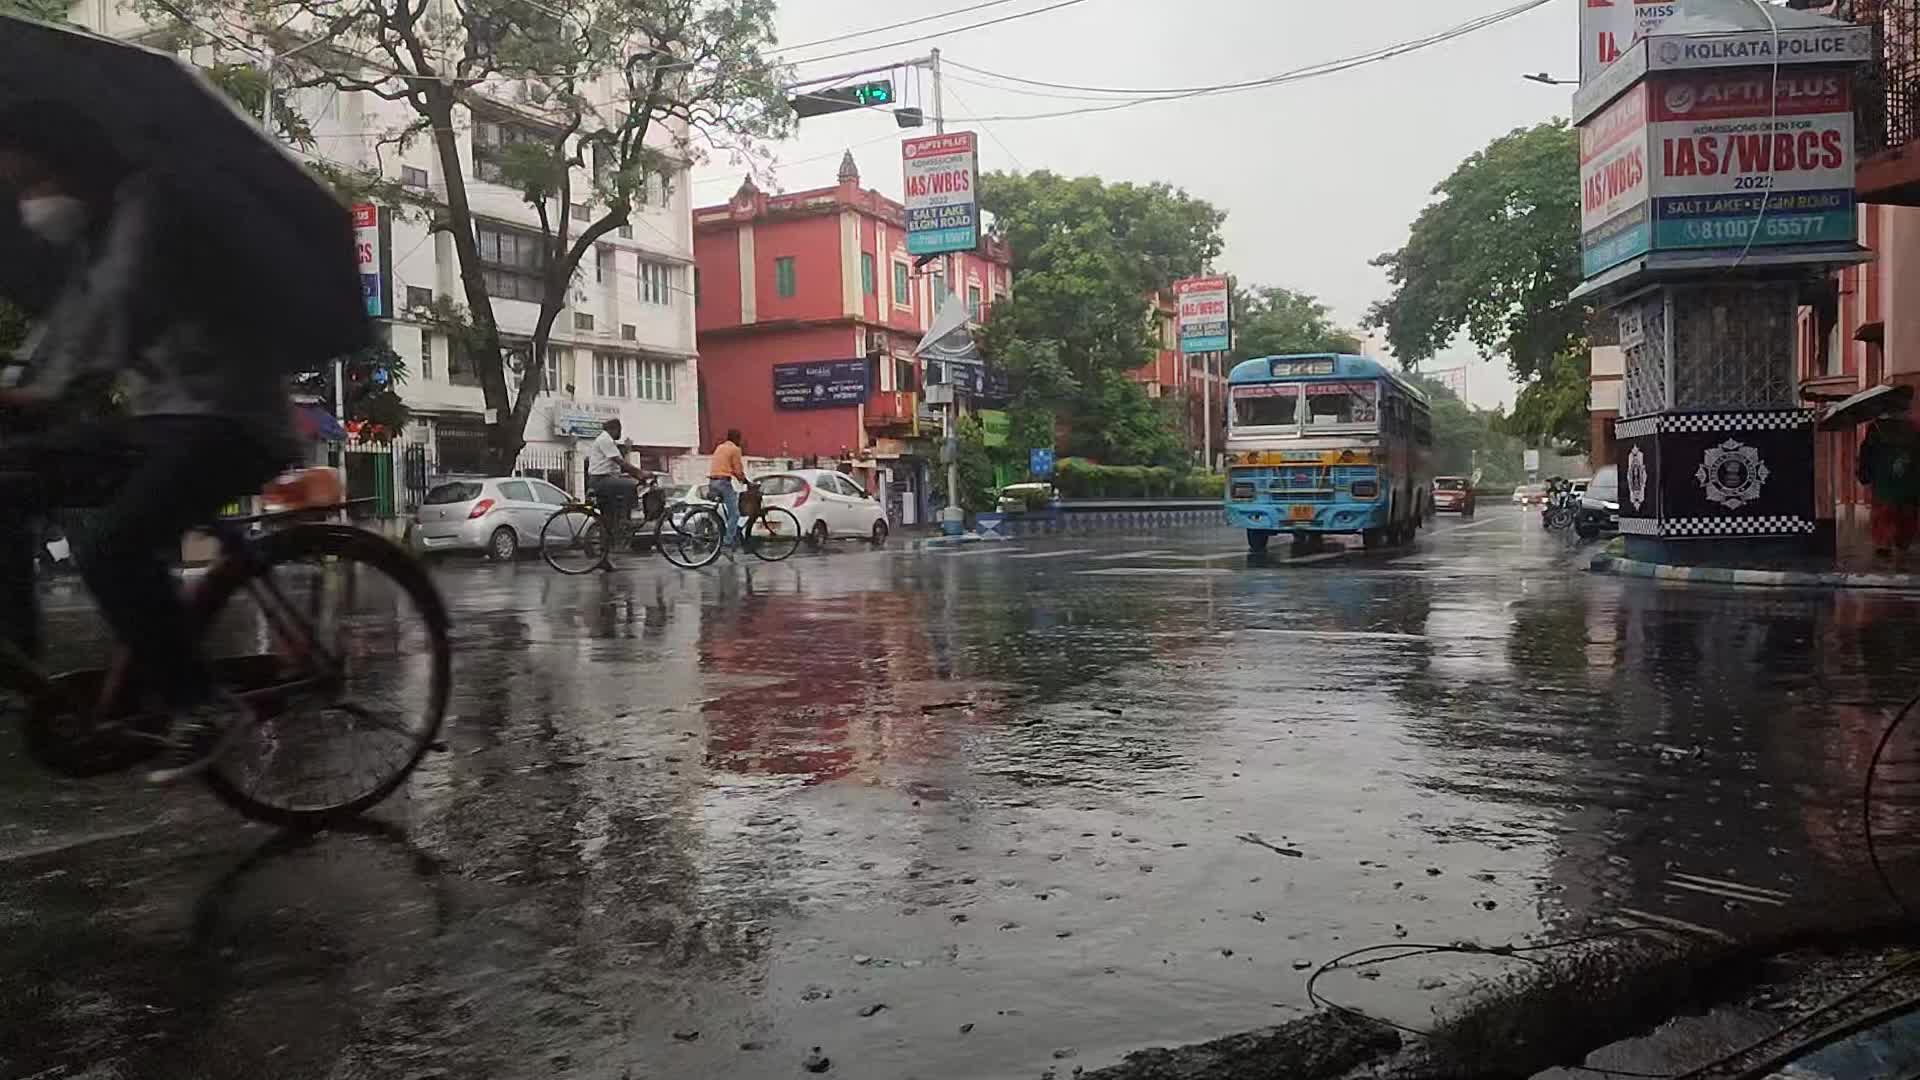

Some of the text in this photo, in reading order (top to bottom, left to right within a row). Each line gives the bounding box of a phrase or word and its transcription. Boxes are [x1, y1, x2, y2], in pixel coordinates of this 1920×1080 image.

[1685, 38, 1845, 58] KOLKATA POLICE
[1664, 130, 1842, 177] IAS/WBCS
[907, 169, 969, 197] IAS/WBCS
[1584, 150, 1643, 213] IAS/WBCS
[1667, 200, 1701, 214] SALT
[1705, 199, 1741, 212] LAKE
[940, 215, 970, 226] ROAD
